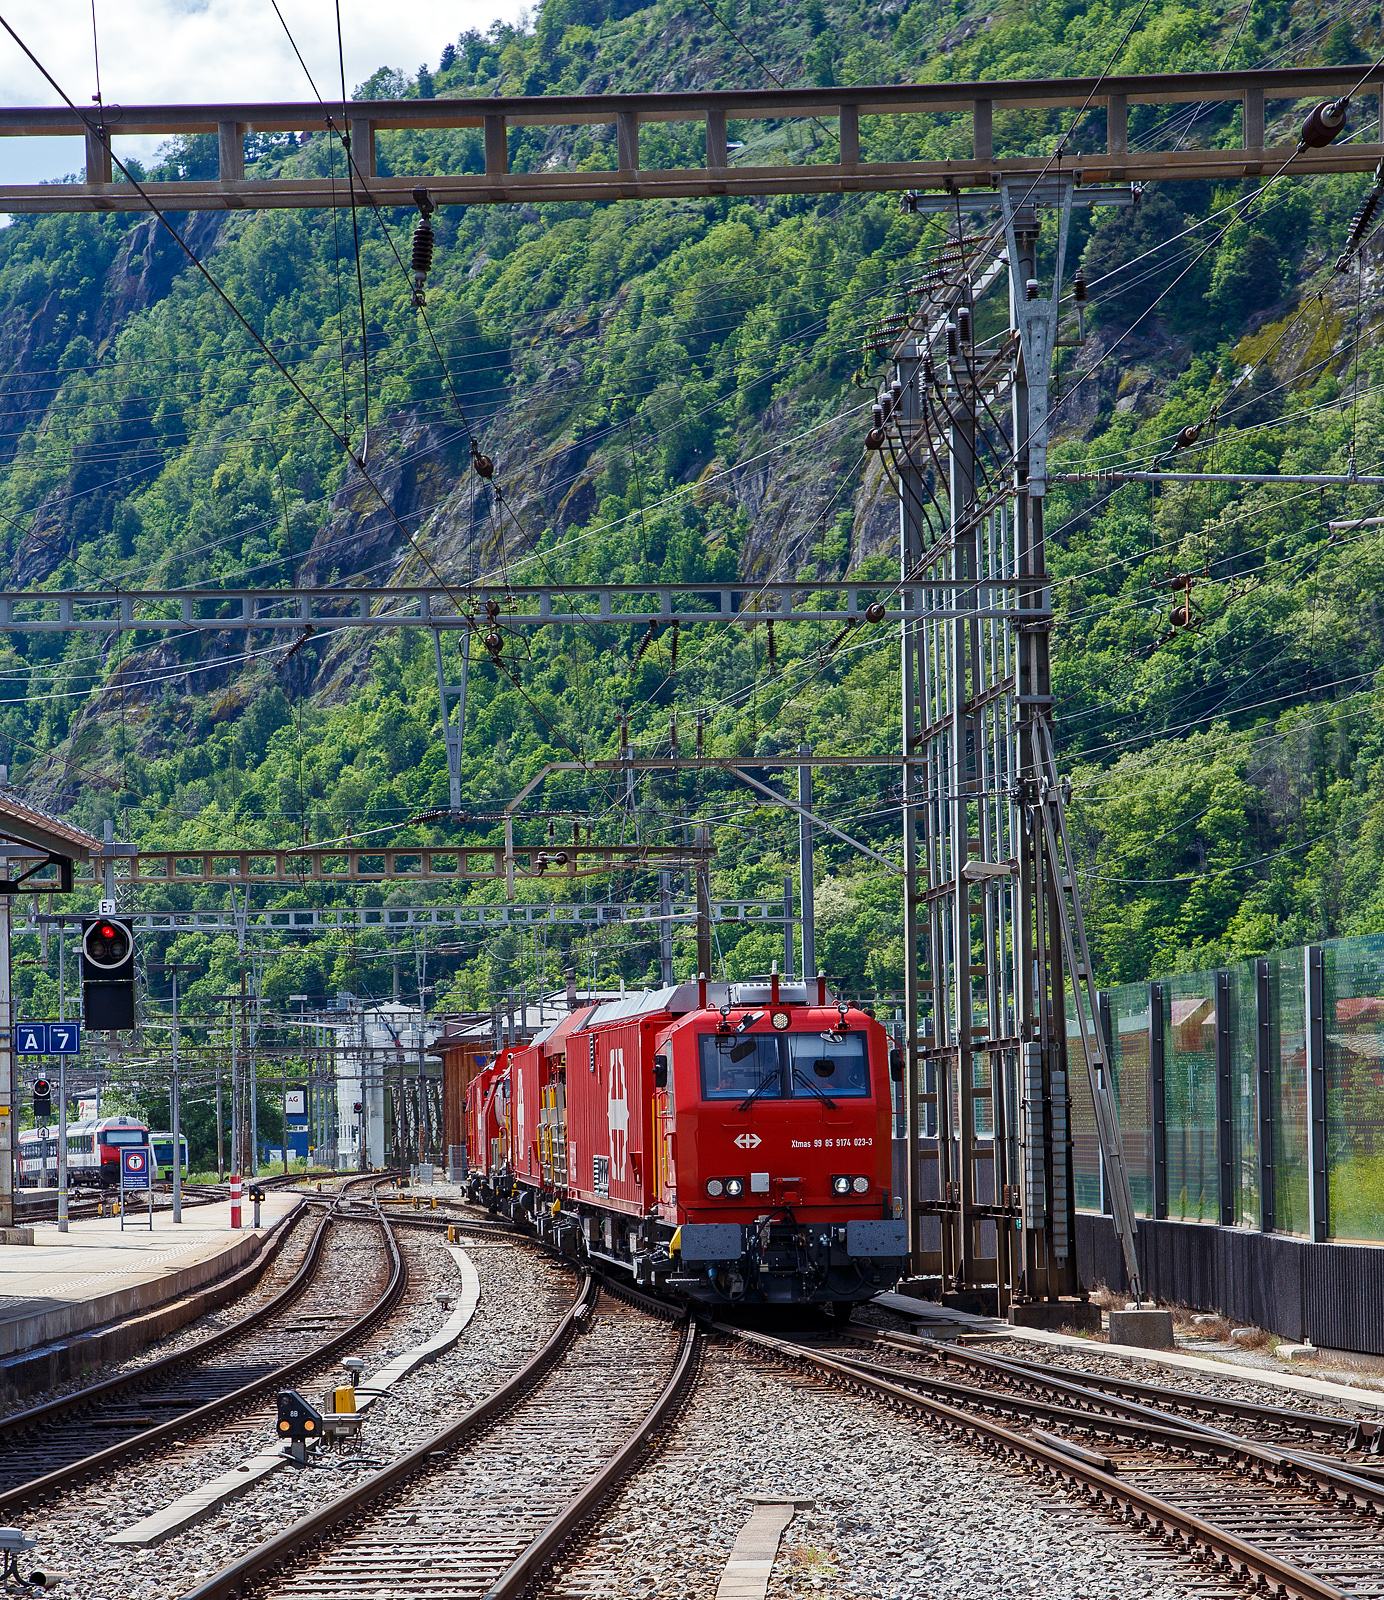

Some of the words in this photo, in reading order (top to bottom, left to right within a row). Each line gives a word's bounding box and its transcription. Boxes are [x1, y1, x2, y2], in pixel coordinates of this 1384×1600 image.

[24, 1033, 38, 1049] A
[57, 1033, 69, 1049] 7
[791, 1139, 811, 1148] Xtmas
[814, 1139, 822, 1147] 99
[825, 1138, 833, 1147] 85
[835, 1138, 851, 1147] 9174
[853, 1137, 873, 1147] 023-3
